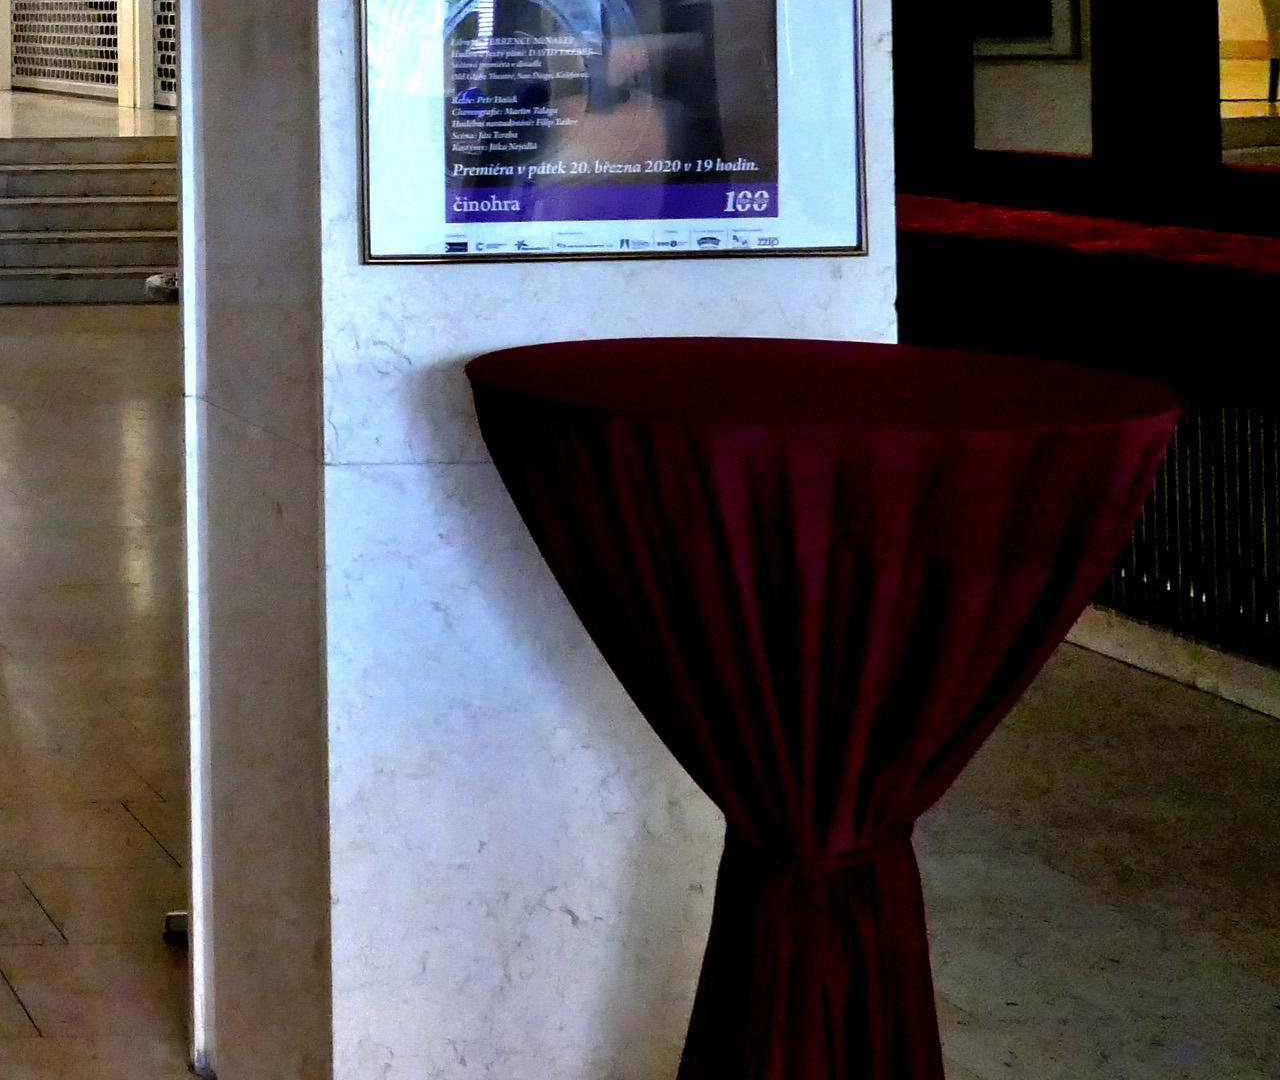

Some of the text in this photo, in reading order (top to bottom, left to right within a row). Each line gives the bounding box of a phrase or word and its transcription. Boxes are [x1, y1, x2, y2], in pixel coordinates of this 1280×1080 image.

[452, 159, 760, 178] Premiéra v pátek 20. března 2020 v 19 hodin.
[452, 197, 521, 212] činohra
[723, 190, 770, 212] 100
